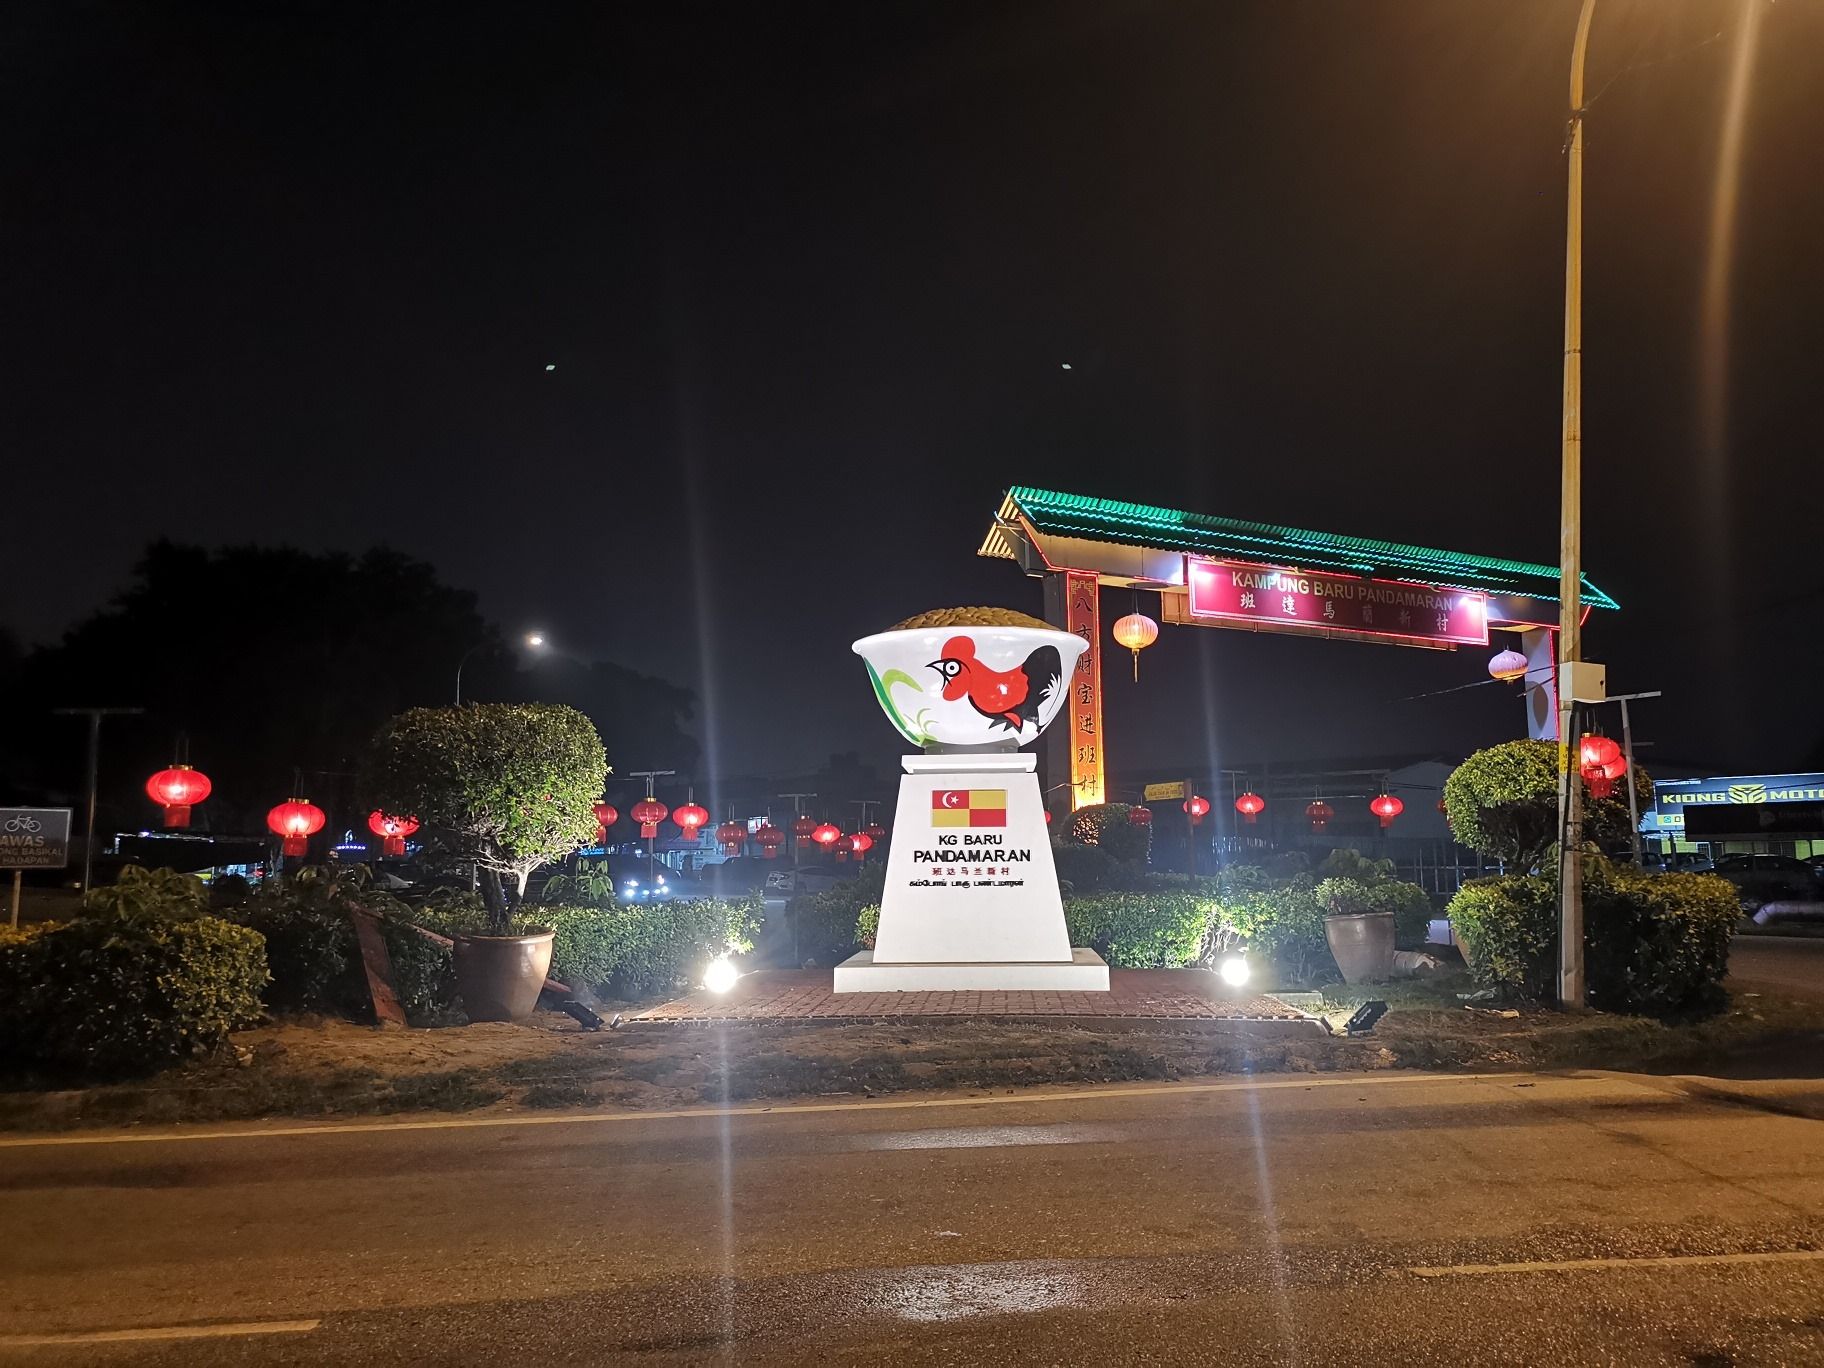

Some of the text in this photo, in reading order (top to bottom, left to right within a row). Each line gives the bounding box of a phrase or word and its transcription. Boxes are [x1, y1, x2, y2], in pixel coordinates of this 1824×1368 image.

[1232, 571, 1453, 611] KAMPUNG BARU PANDAMARAN
[1662, 793, 1726, 804] KIONG
[938, 834, 1003, 846] KG BARU
[913, 849, 1032, 863] PANDAMARAN
